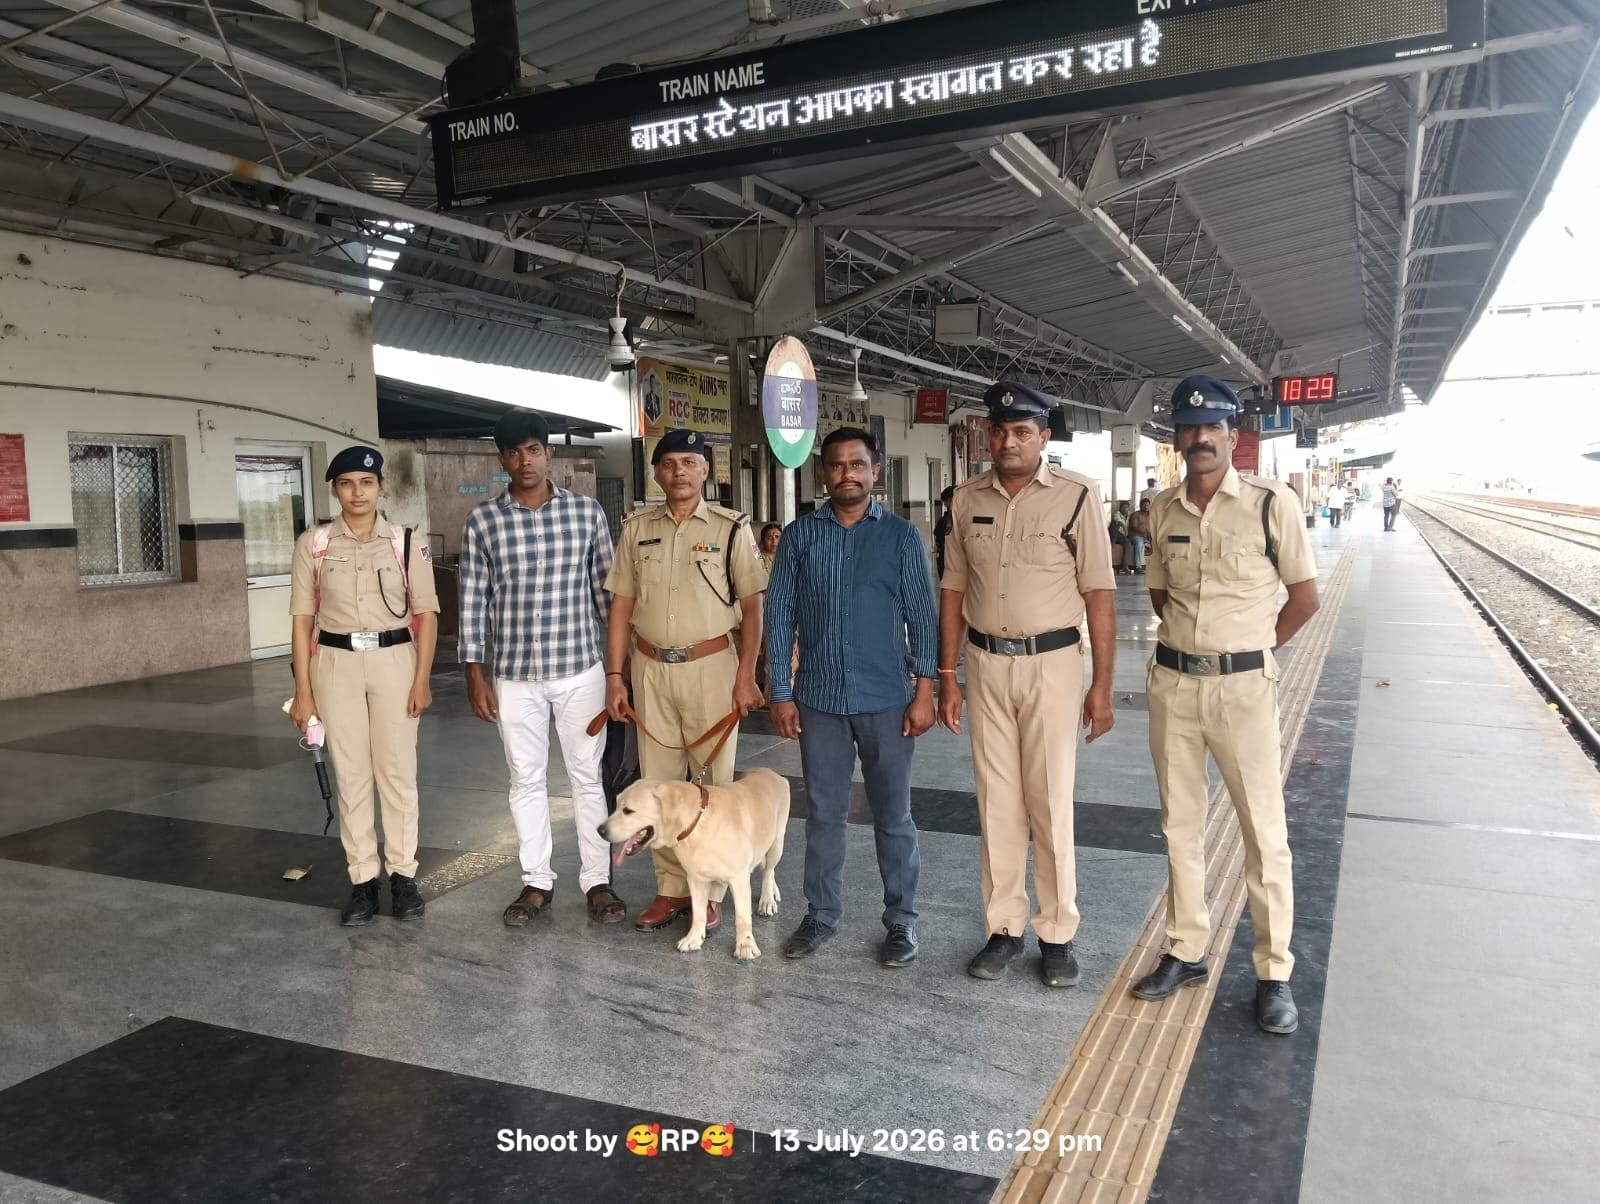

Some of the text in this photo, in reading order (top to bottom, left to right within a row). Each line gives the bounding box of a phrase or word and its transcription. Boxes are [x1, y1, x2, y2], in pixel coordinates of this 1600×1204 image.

[630, 18, 1163, 150] बासर स्टेशन आपका स्वागत कर रहा है
[659, 62, 765, 103] TRAIN NAME
[448, 111, 520, 142] TRAIN NO.
[699, 375, 718, 397] AIIMS
[1282, 377, 1334, 401] 18 29
[669, 399, 690, 418] RCC
[781, 414, 802, 428] BASAR
